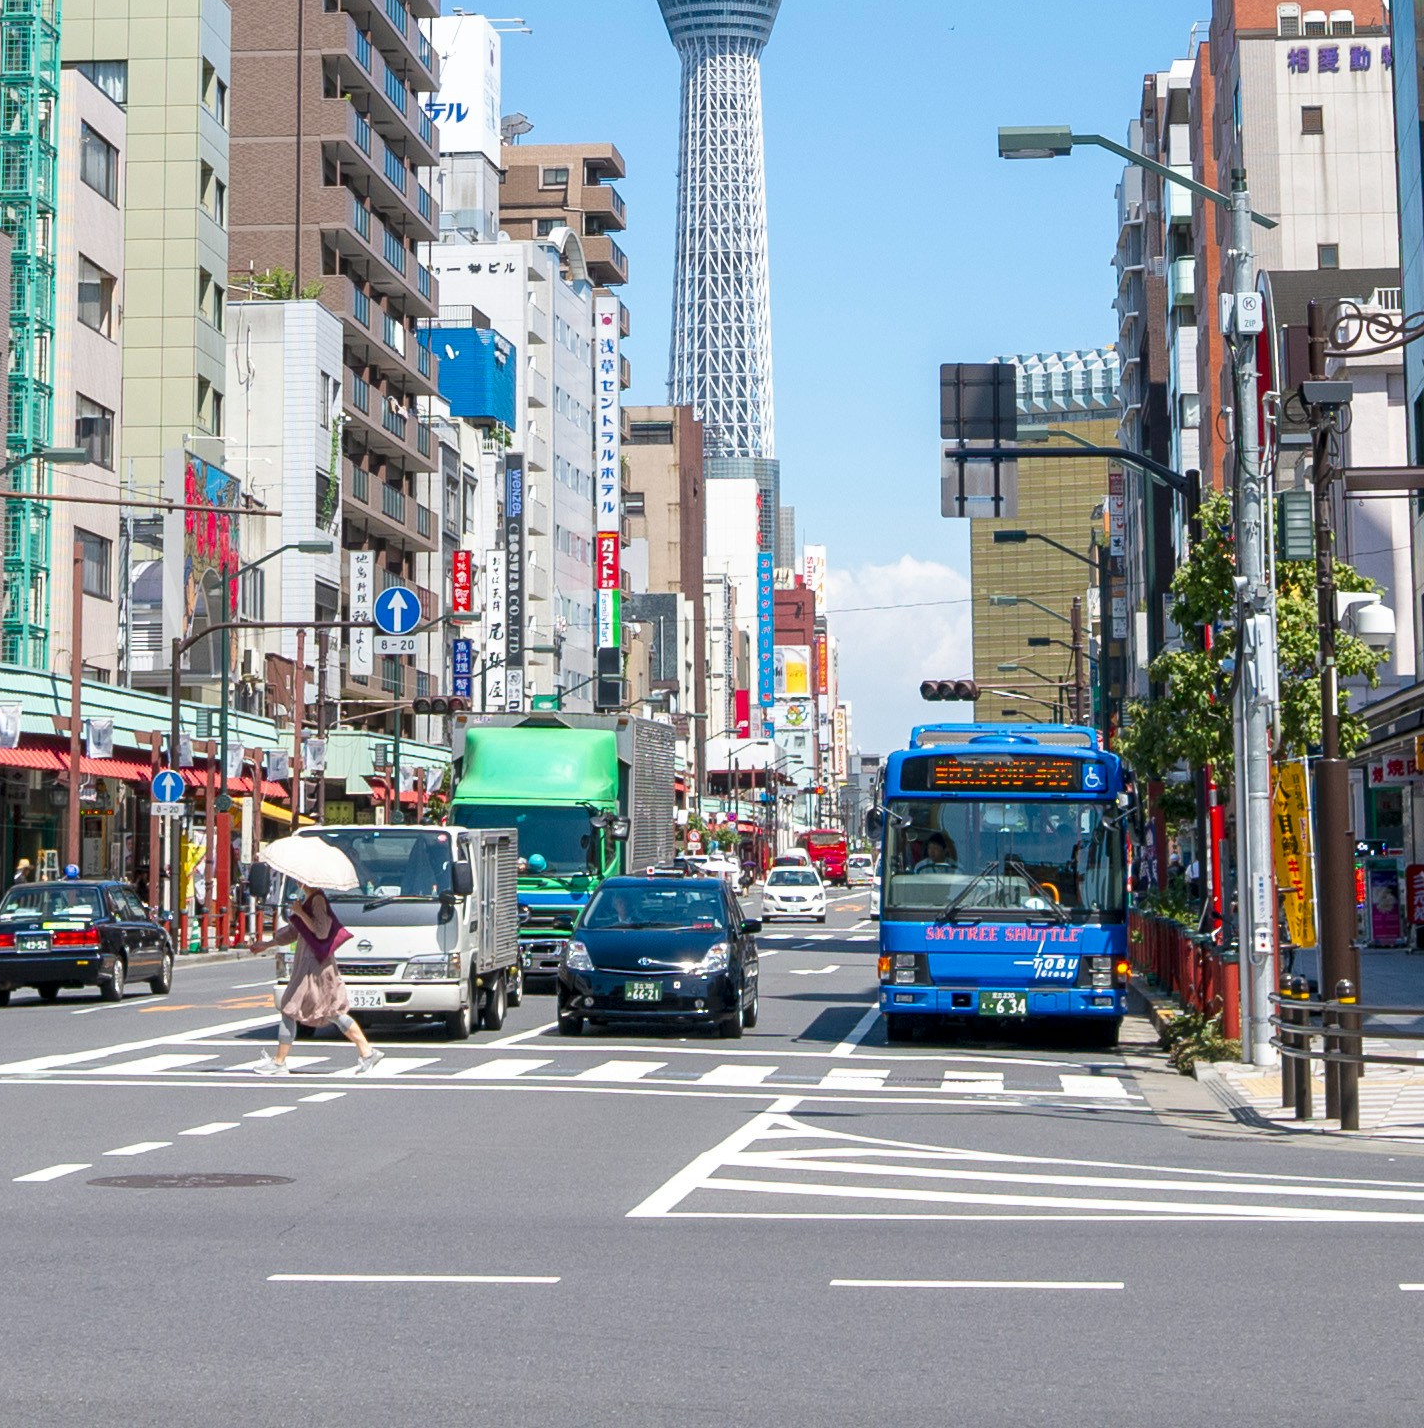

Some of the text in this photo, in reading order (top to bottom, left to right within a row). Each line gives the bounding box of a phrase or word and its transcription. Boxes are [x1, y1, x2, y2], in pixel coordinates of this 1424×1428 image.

[599, 339, 615, 514] 浅草セントラルホテル
[602, 538, 615, 579] ガスト
[601, 593, 610, 643] FamilyMart
[925, 927, 1082, 942] SKYTREE SHUTTLE
[1033, 956, 1078, 970] TOBU
[1041, 969, 1074, 979] Group
[353, 996, 381, 1007] 93-24
[633, 989, 659, 1000] 66-21
